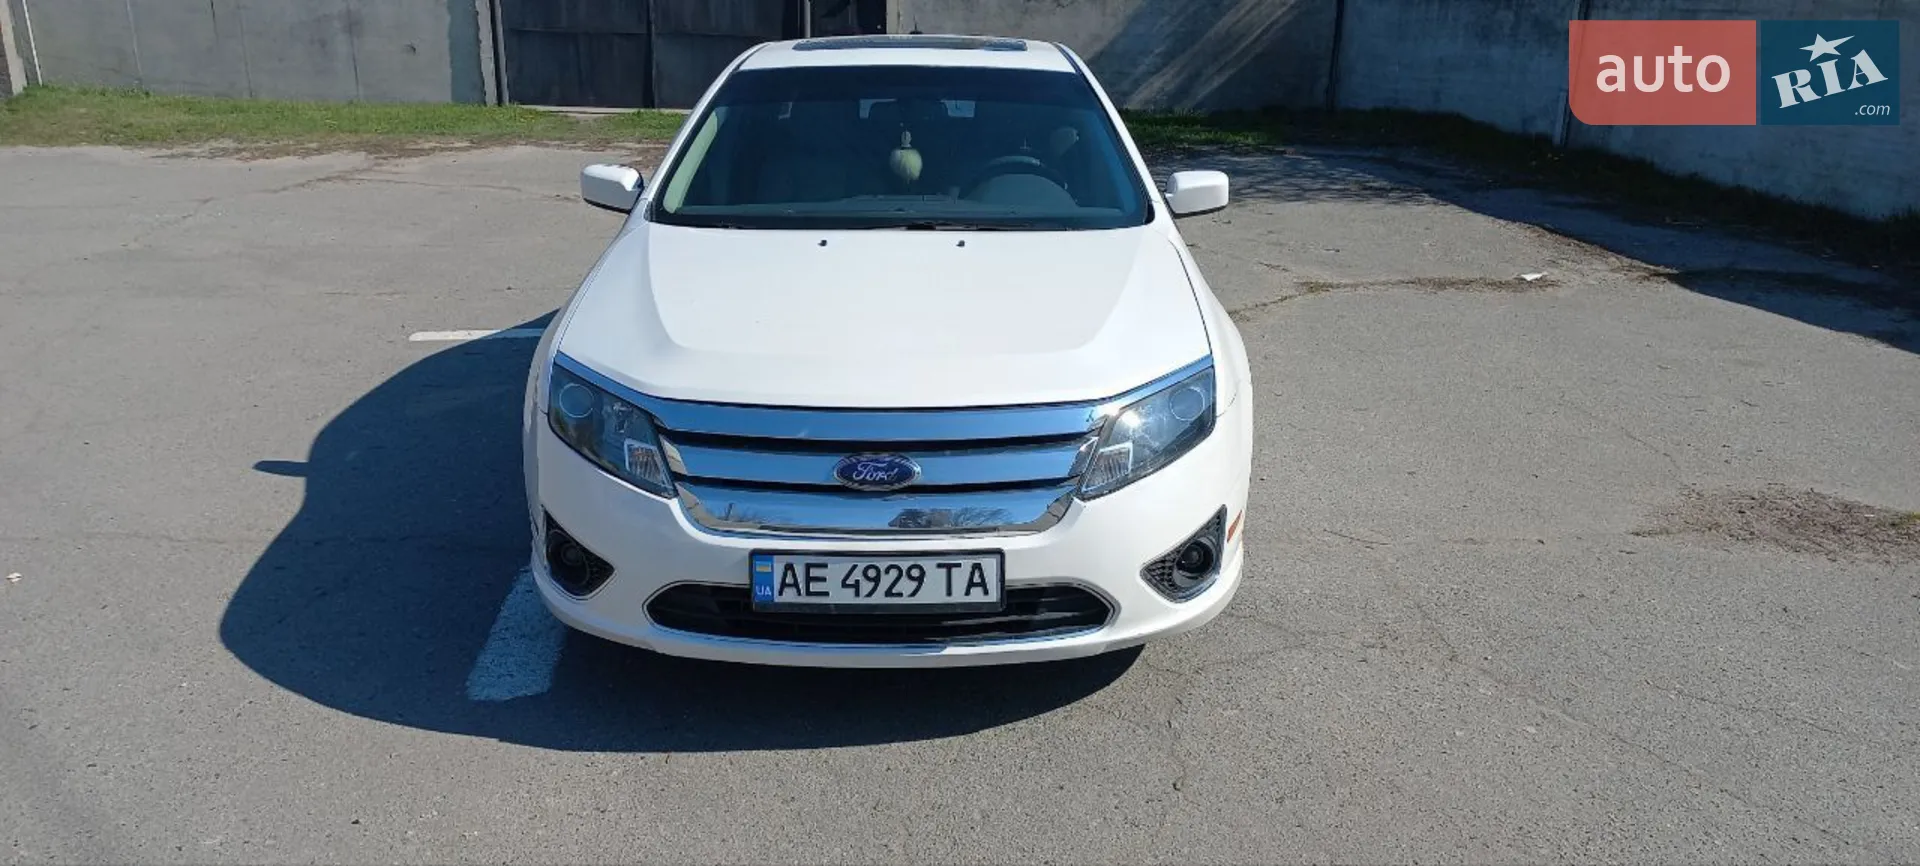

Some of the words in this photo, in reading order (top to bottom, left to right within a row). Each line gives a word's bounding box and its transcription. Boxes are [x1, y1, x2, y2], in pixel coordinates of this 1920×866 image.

[853, 461, 899, 481] Ford
[778, 562, 830, 597] AE
[841, 563, 927, 598] 4929
[936, 562, 990, 597] TA
[756, 587, 773, 596] UA
